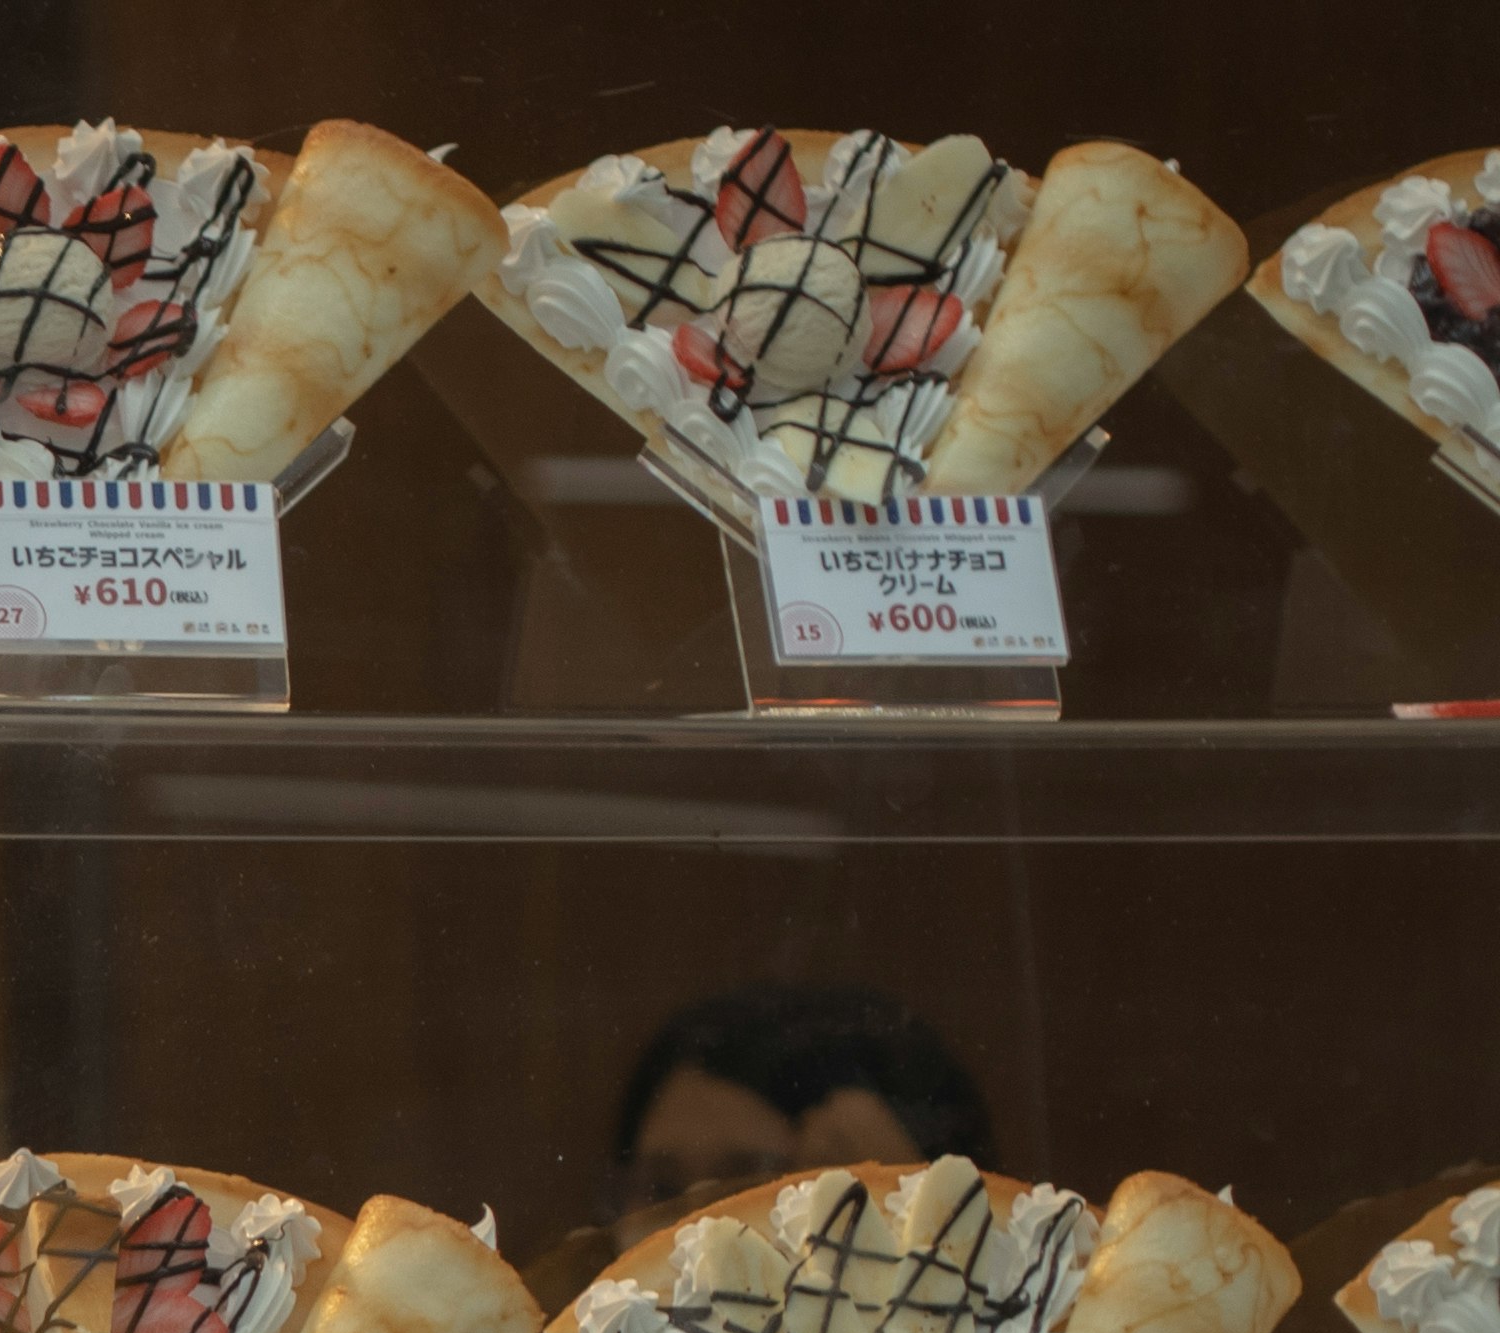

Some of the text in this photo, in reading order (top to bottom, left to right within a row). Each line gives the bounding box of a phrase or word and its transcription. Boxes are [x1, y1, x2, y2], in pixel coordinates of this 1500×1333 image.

[13, 546, 246, 570] いちごチョコスペシャル
[820, 550, 1006, 571] いちごバナナチョコ
[74, 578, 167, 606] ¥610
[879, 574, 956, 596] クリーム
[869, 604, 957, 632] ¥600
[796, 625, 821, 641] 15
